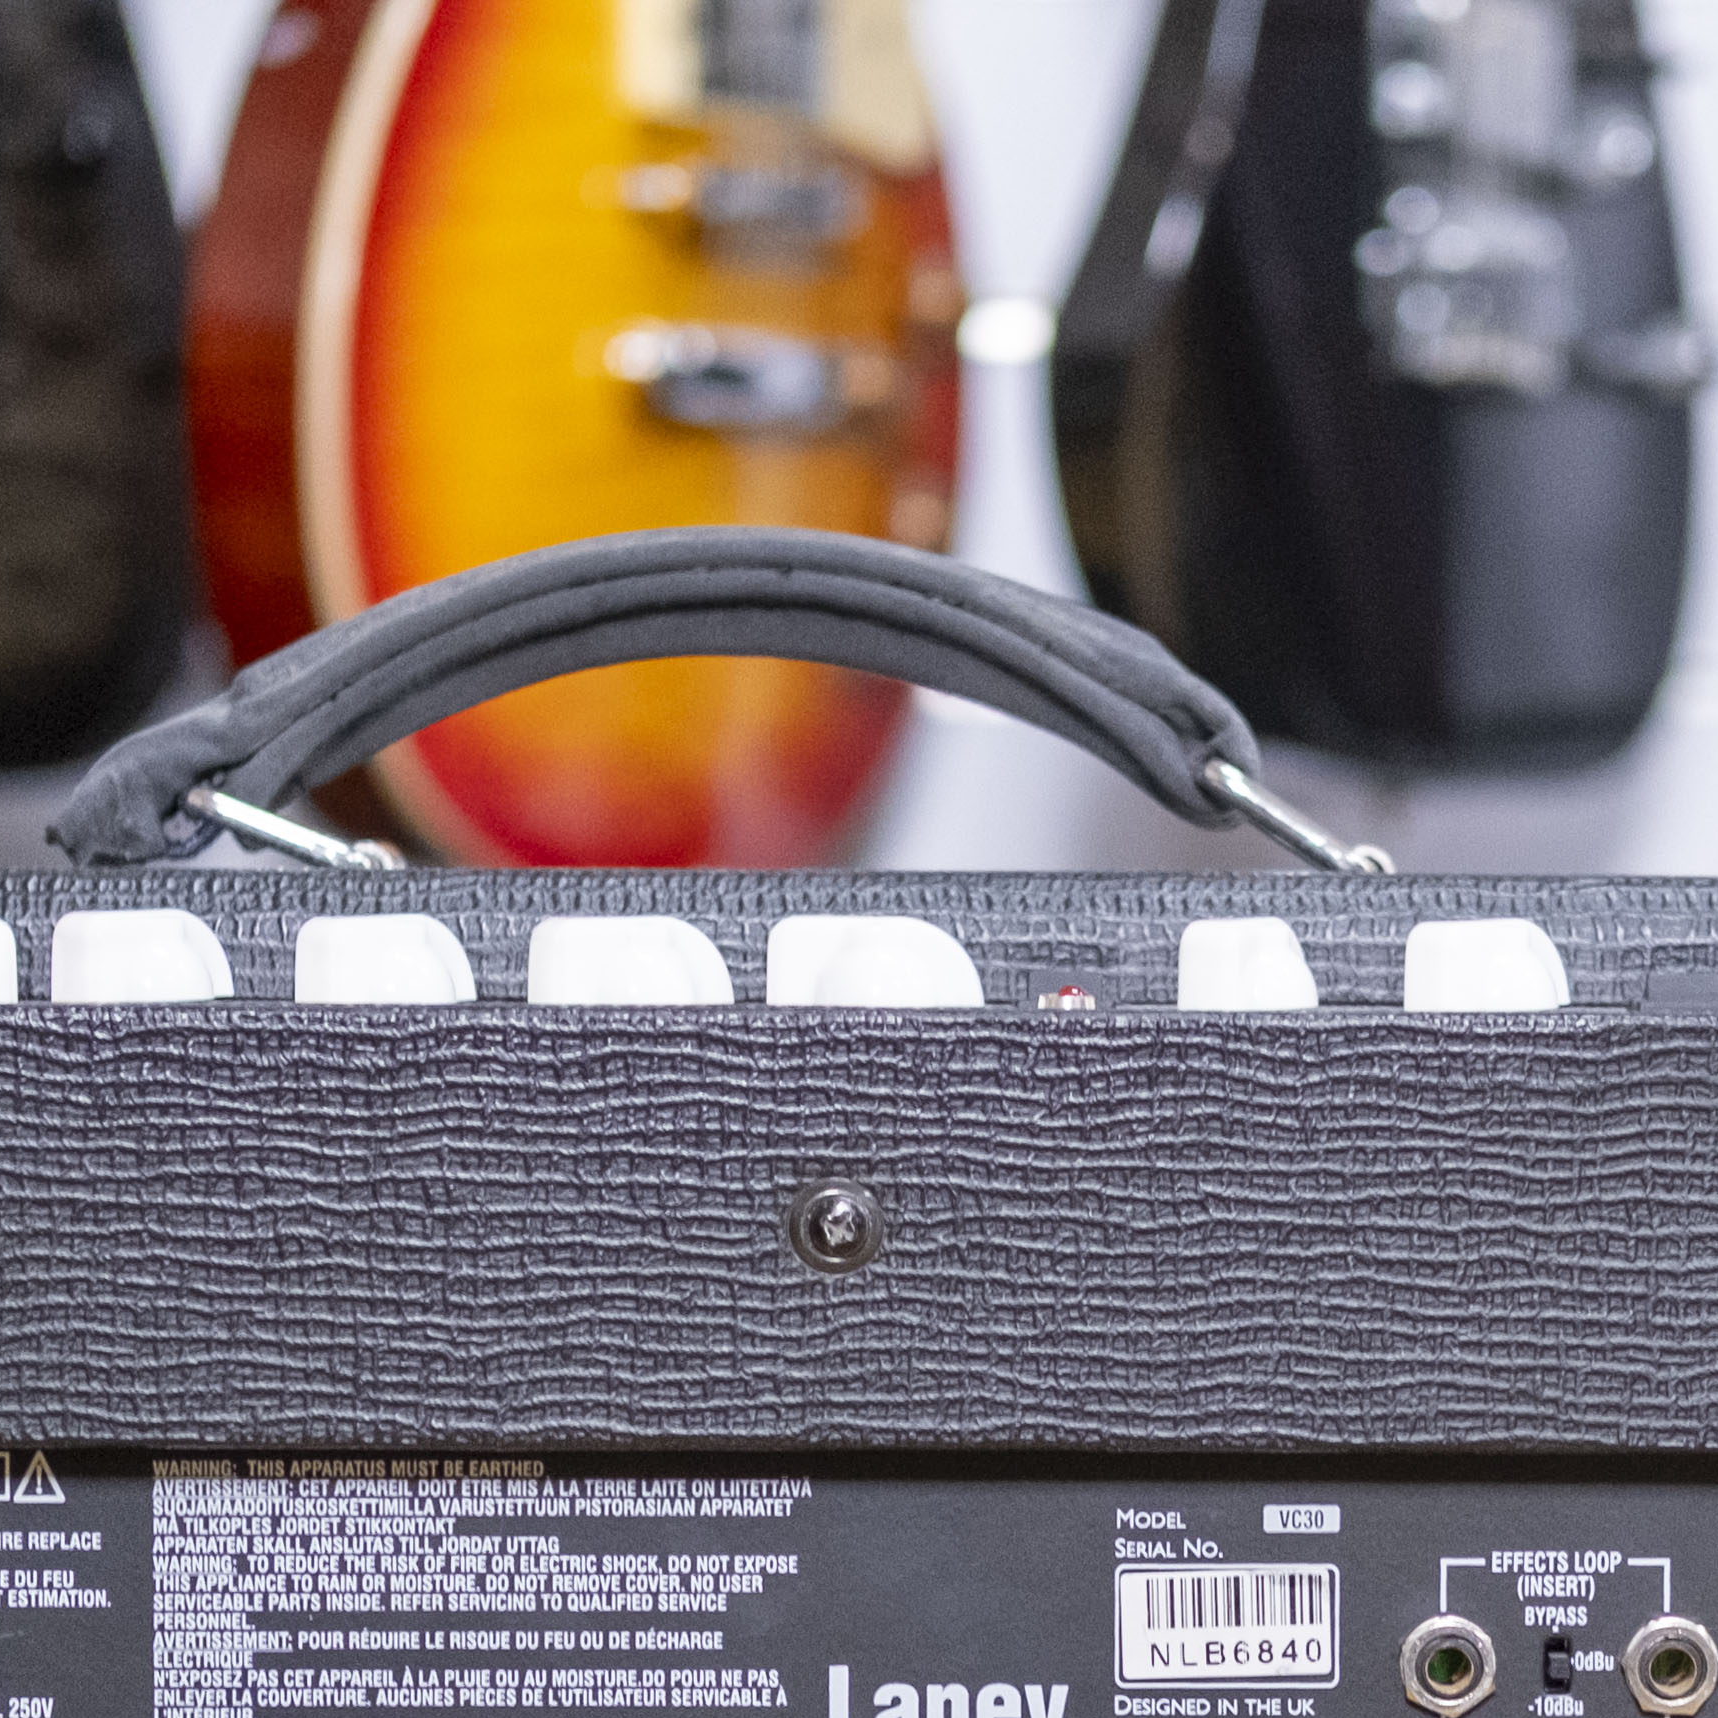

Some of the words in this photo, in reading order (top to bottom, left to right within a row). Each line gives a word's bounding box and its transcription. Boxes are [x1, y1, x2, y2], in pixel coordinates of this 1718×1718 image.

[153, 1460, 237, 1477] WARNING:
[249, 1460, 285, 1477] THIS
[289, 1460, 386, 1477] APPARATUS
[391, 1460, 438, 1477] MUST
[443, 1460, 463, 1477] BE
[469, 1460, 544, 1477] EARTHED
[1279, 1510, 1324, 1530] VC30
[28, 1532, 102, 1550] REPLACE
[153, 1555, 237, 1573] WARNING:
[247, 1555, 269, 1573] TO
[273, 1555, 340, 1573] REDUCE
[344, 1555, 376, 1573] THE
[380, 1555, 419, 1573] RISK
[423, 1555, 446, 1573] OF
[450, 1555, 487, 1573] FIRE
[491, 1555, 515, 1573] OR
[519, 1555, 597, 1573] ELECTRIC
[667, 1555, 692, 1573] DO
[696, 1555, 730, 1573] NOT
[734, 1555, 798, 1573] EXPOSE
[1490, 1551, 1569, 1573] EFFECTS
[1574, 1551, 1622, 1573] LOOP
[153, 1574, 191, 1592] THIS
[195, 1574, 287, 1592] APPLIANCE
[291, 1574, 313, 1592] TO
[317, 1574, 358, 1592] RAIN
[361, 1574, 386, 1592] OR
[390, 1574, 480, 1592] MOISTURE.
[485, 1574, 510, 1592] DO
[513, 1574, 548, 1592] NOT
[552, 1574, 621, 1592] REMOVE
[625, 1574, 685, 1592] COVER.
[690, 1574, 715, 1592] NO
[719, 1574, 763, 1592] USER
[1517, 1575, 1595, 1601] (INSERT)
[153, 1593, 264, 1611] SERVICEABLE
[268, 1593, 321, 1611] PARTS
[326, 1593, 385, 1611] INSIDE.
[390, 1593, 444, 1611] REFER
[448, 1593, 537, 1611] SERVICING
[541, 1593, 563, 1611] TO
[567, 1593, 653, 1611] QUALIFIED
[657, 1593, 727, 1611] SERVICE
[153, 1612, 256, 1630] PERSONNEL.
[1524, 1606, 1588, 1627] BYPASS
[1151, 1638, 1323, 1667] NLB6840
[1287, 1695, 1316, 1716] UK
[1527, 1696, 1584, 1717] -10dBu
